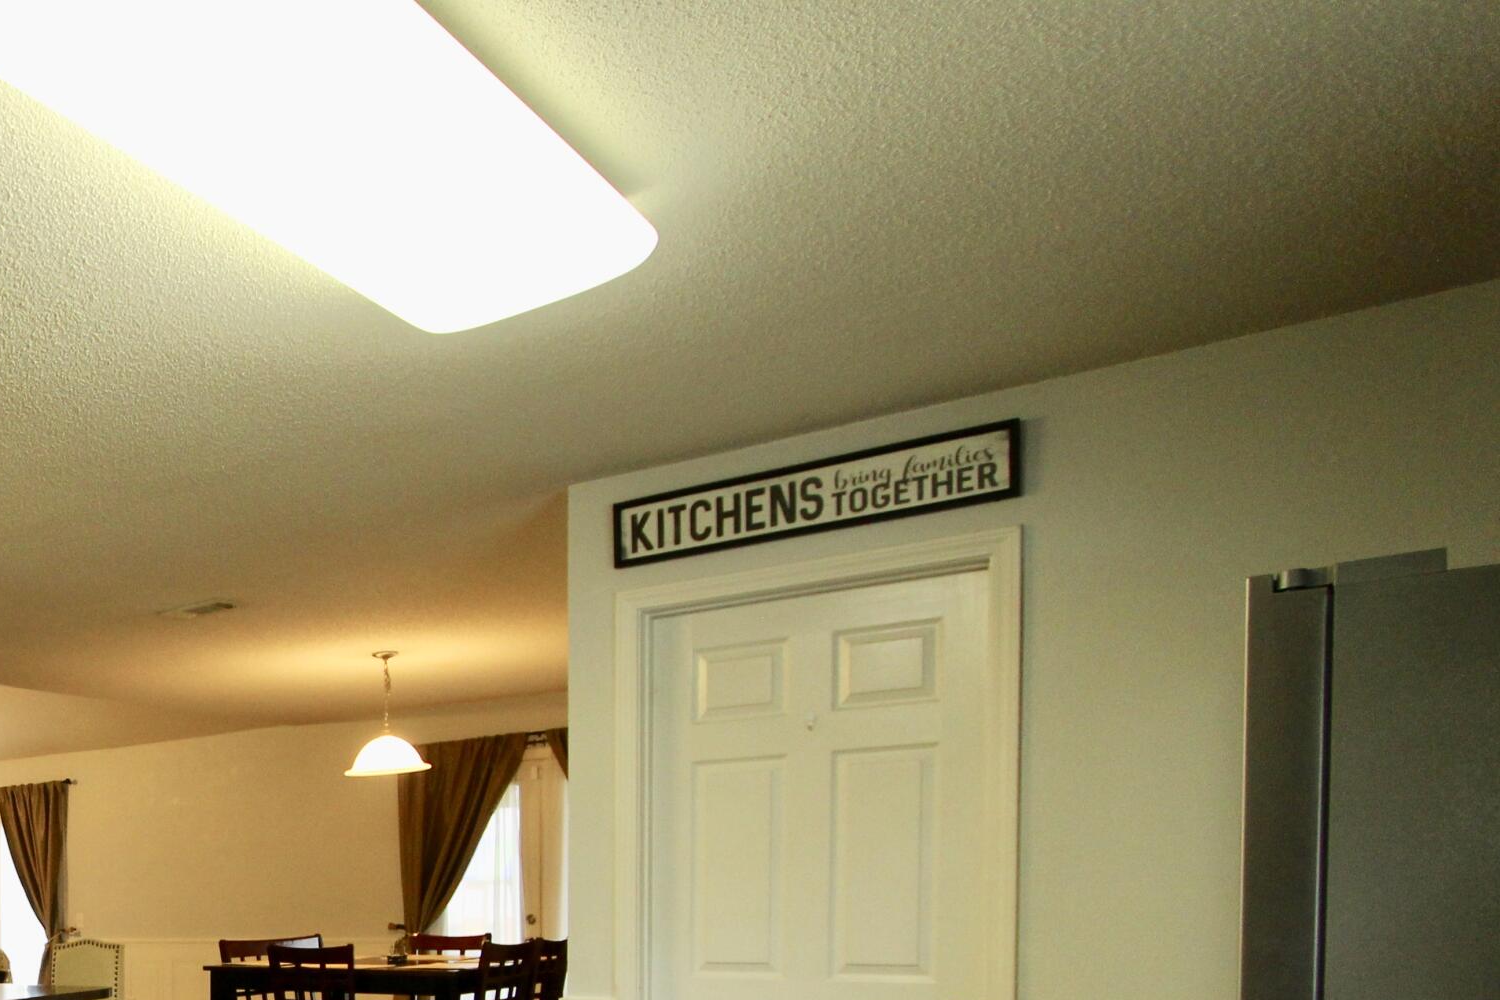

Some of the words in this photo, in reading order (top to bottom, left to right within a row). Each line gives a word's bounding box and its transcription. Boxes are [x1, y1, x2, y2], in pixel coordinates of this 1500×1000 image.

[832, 462, 1000, 517] TOGETHER
[834, 468, 893, 491] bring
[902, 444, 997, 482] families
[630, 476, 825, 555] KITCHENS
